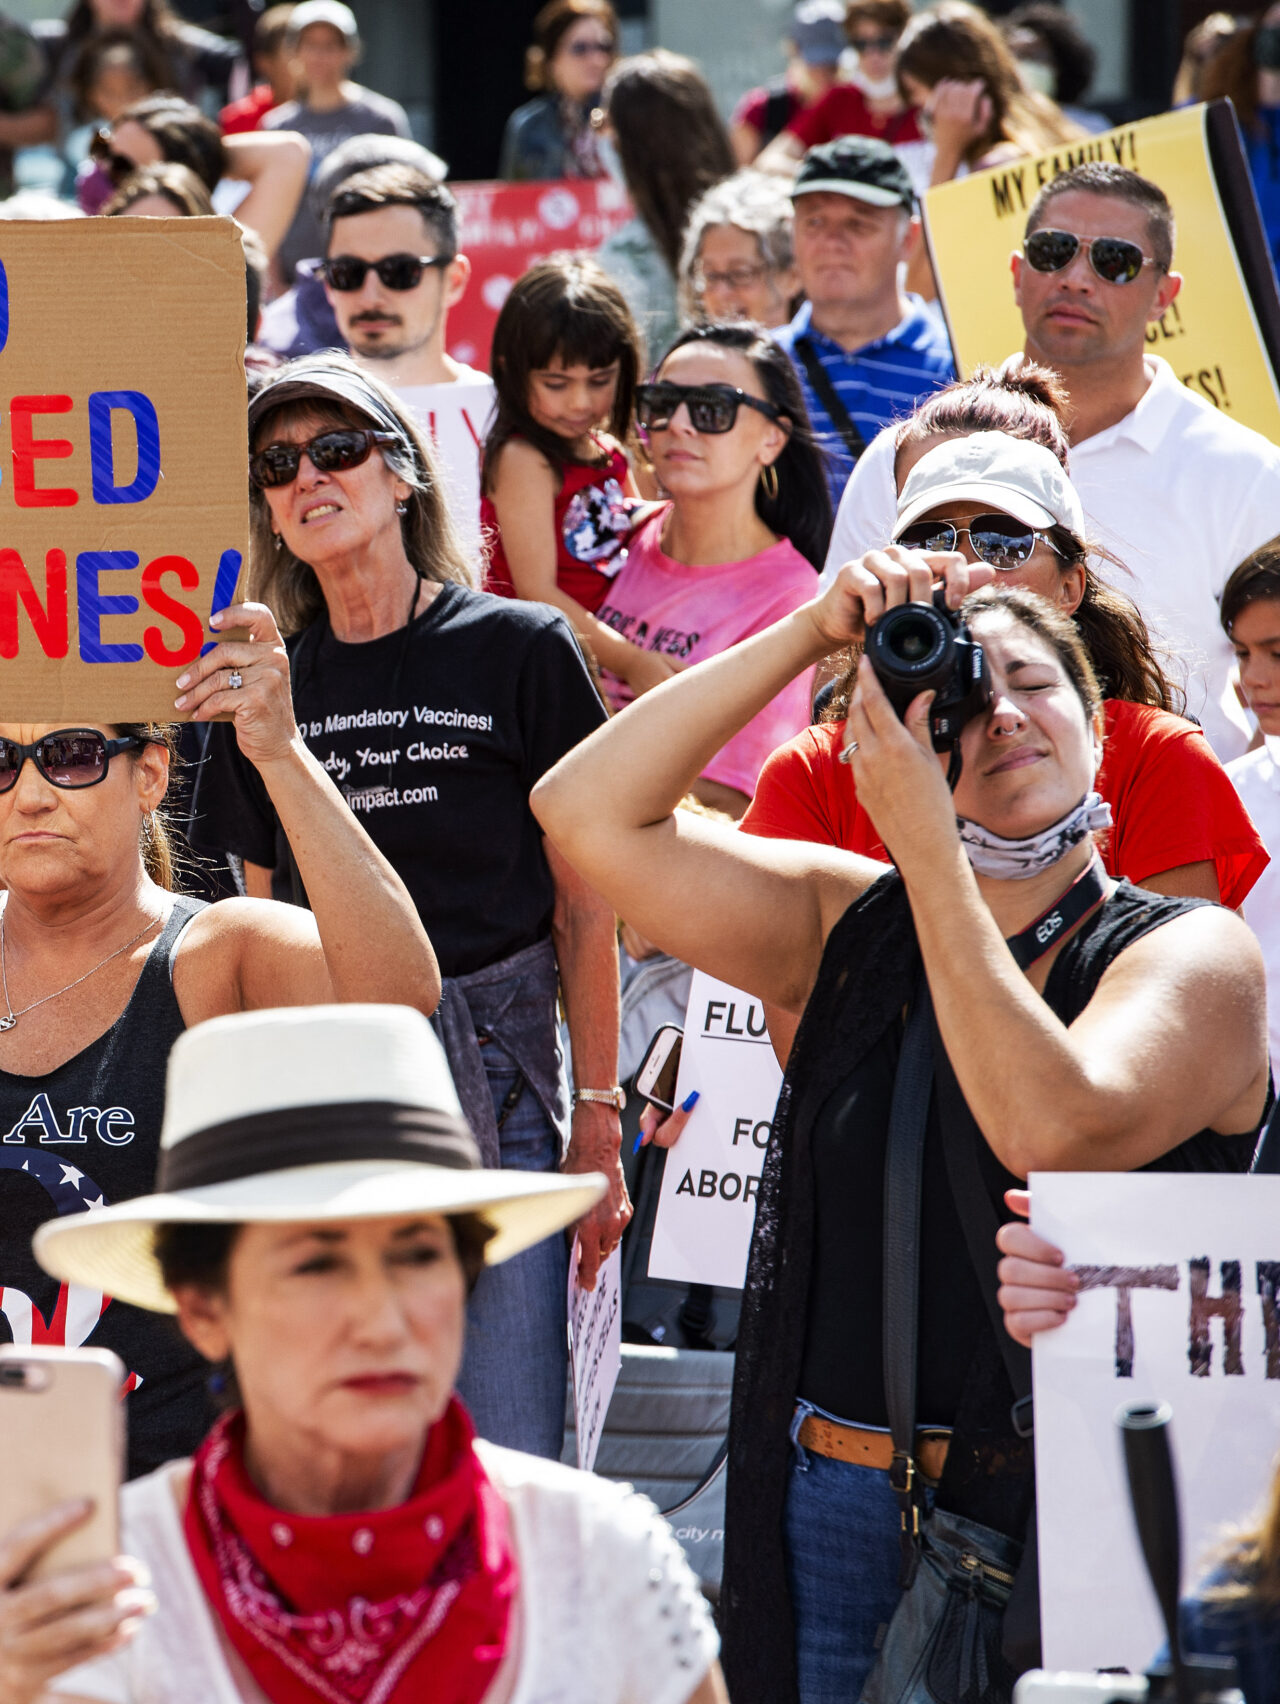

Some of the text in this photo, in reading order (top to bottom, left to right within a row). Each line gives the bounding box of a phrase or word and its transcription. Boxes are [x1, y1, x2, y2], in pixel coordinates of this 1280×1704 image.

[991, 167, 1026, 219] MY
[310, 720, 323, 738] to
[325, 708, 410, 735] Mandatory
[413, 705, 494, 732] Vaccines!
[355, 747, 401, 768] Your
[406, 740, 470, 763] Choice
[1035, 910, 1064, 944] EOS
[703, 1000, 768, 1038] FLU
[2, 1092, 136, 1147] Are
[675, 1524, 710, 1544] city
